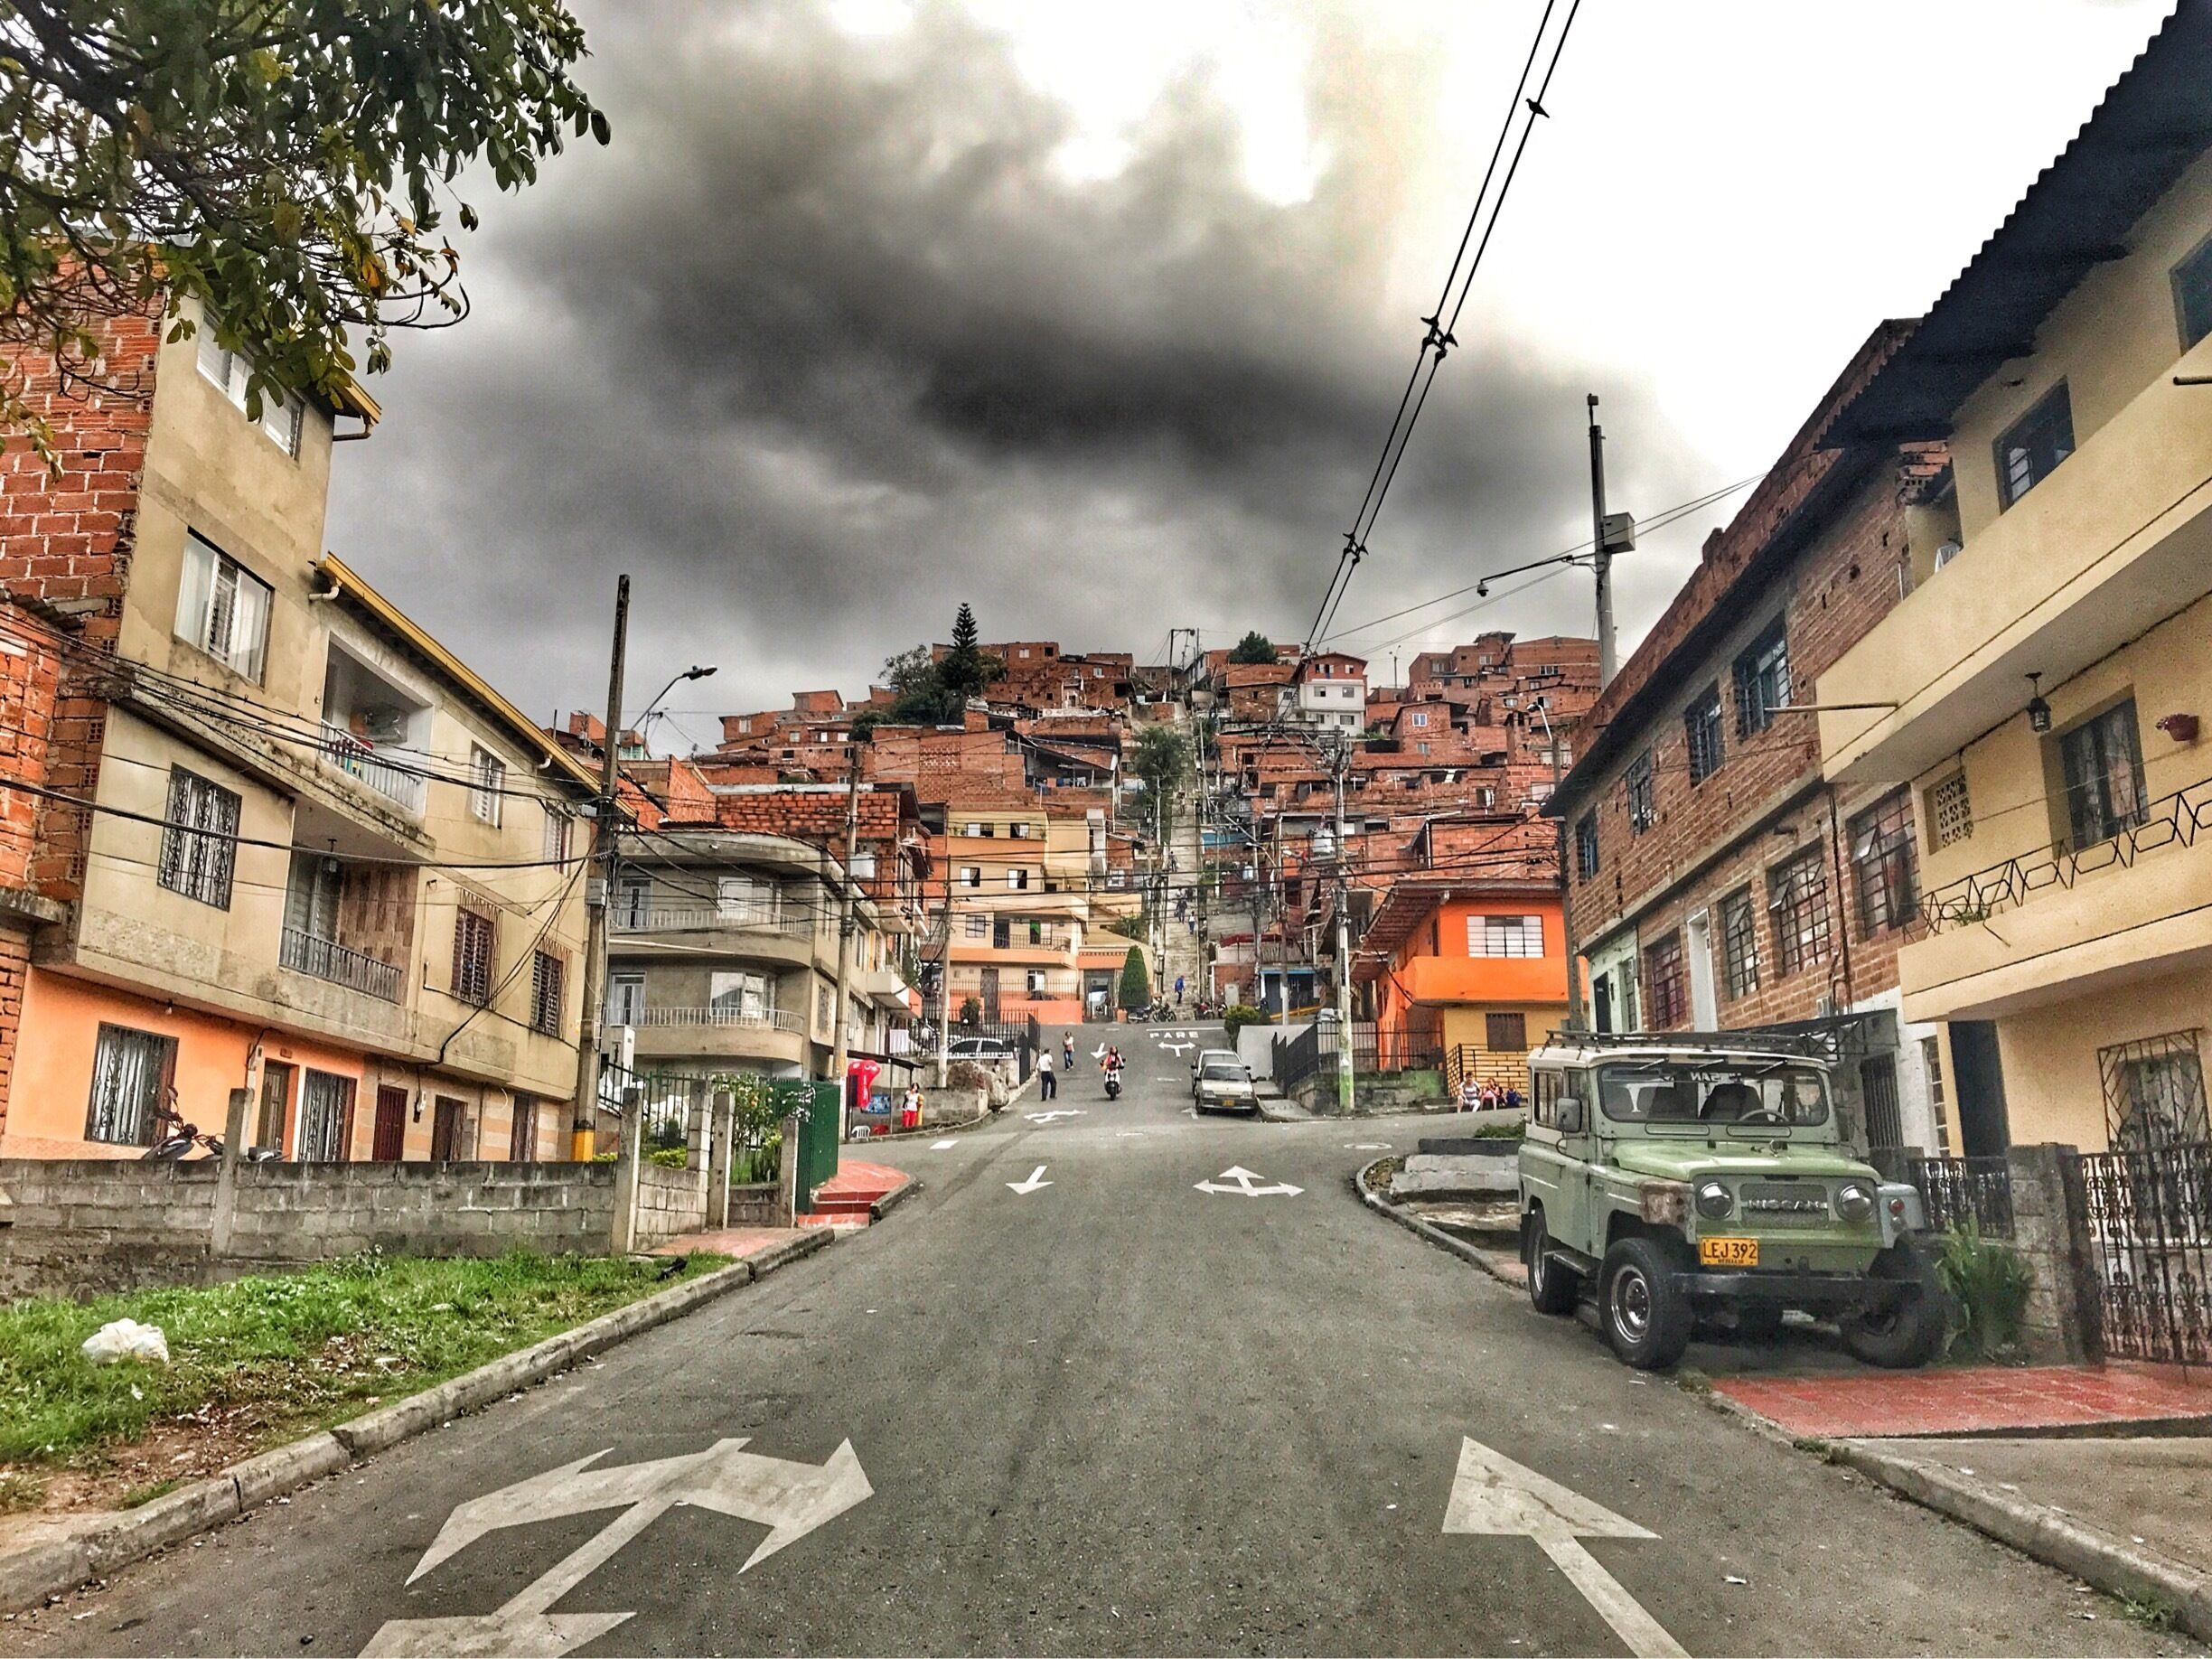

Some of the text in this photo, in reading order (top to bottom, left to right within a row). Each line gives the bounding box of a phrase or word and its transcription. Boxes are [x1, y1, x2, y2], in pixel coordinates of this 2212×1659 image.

[1748, 1199, 1820, 1210] NISSAN
[1703, 1242, 1757, 1259] LEJ 392
